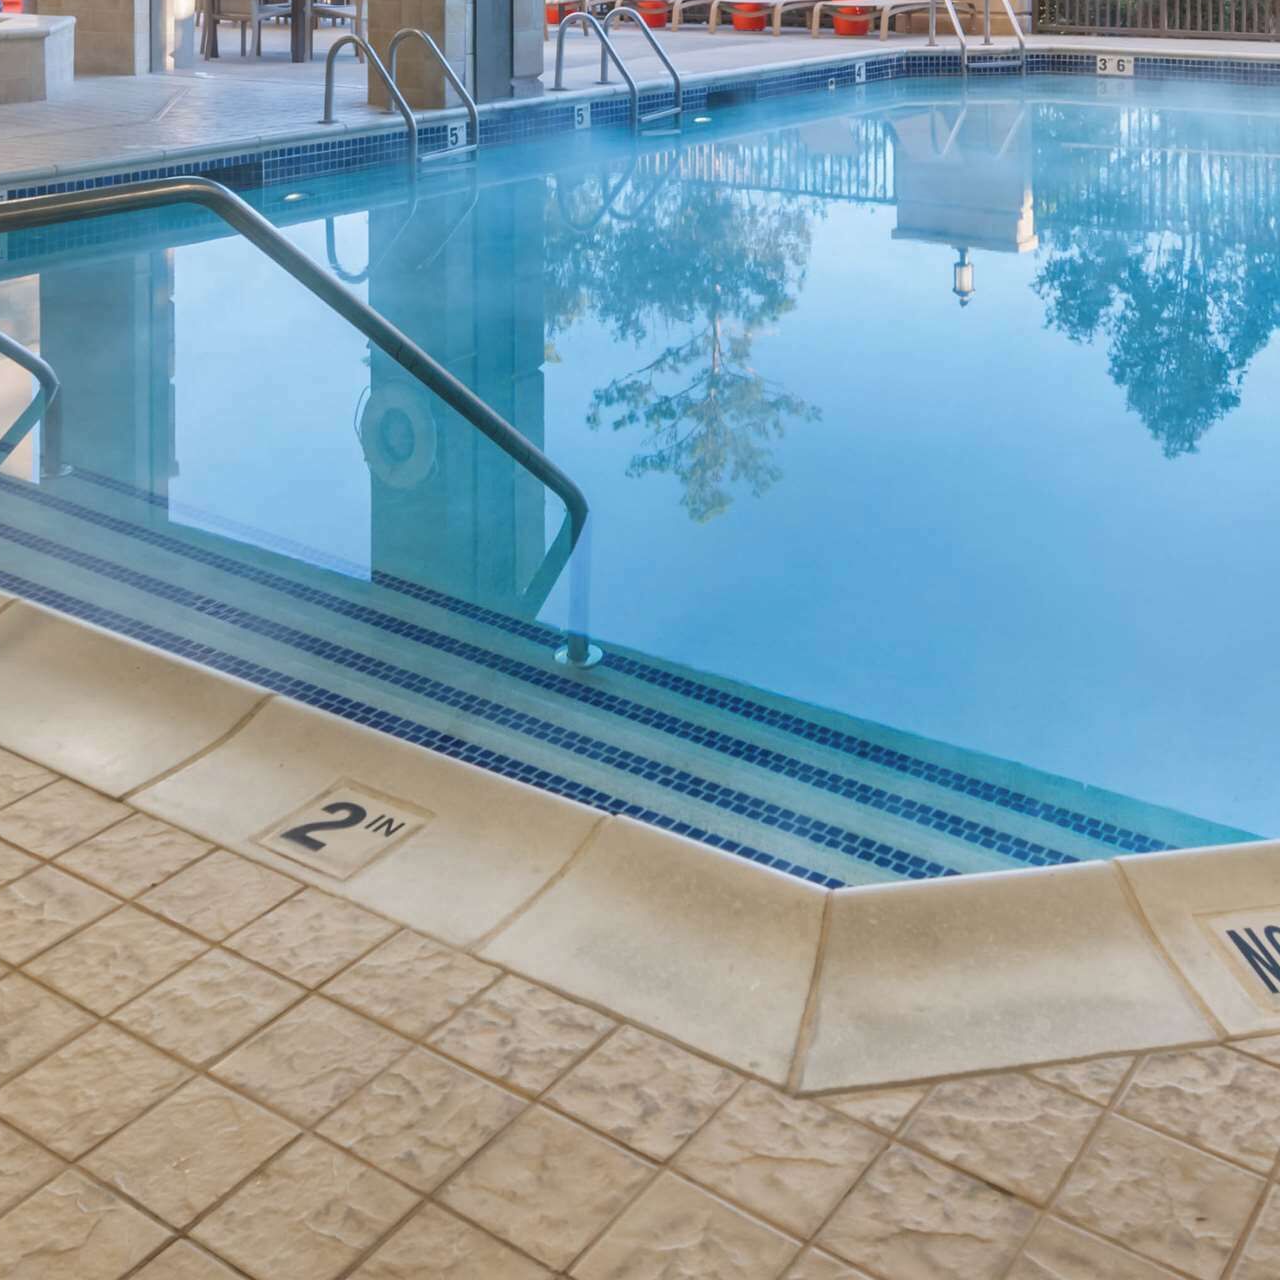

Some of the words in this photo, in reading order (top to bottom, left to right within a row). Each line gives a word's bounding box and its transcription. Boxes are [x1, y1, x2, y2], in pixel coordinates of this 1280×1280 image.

[1099, 58, 1107, 71] 3
[1117, 59, 1125, 72] 6
[577, 108, 584, 125] 5
[450, 127, 458, 145] 5
[280, 802, 367, 852] 2
[364, 814, 405, 838] IN
